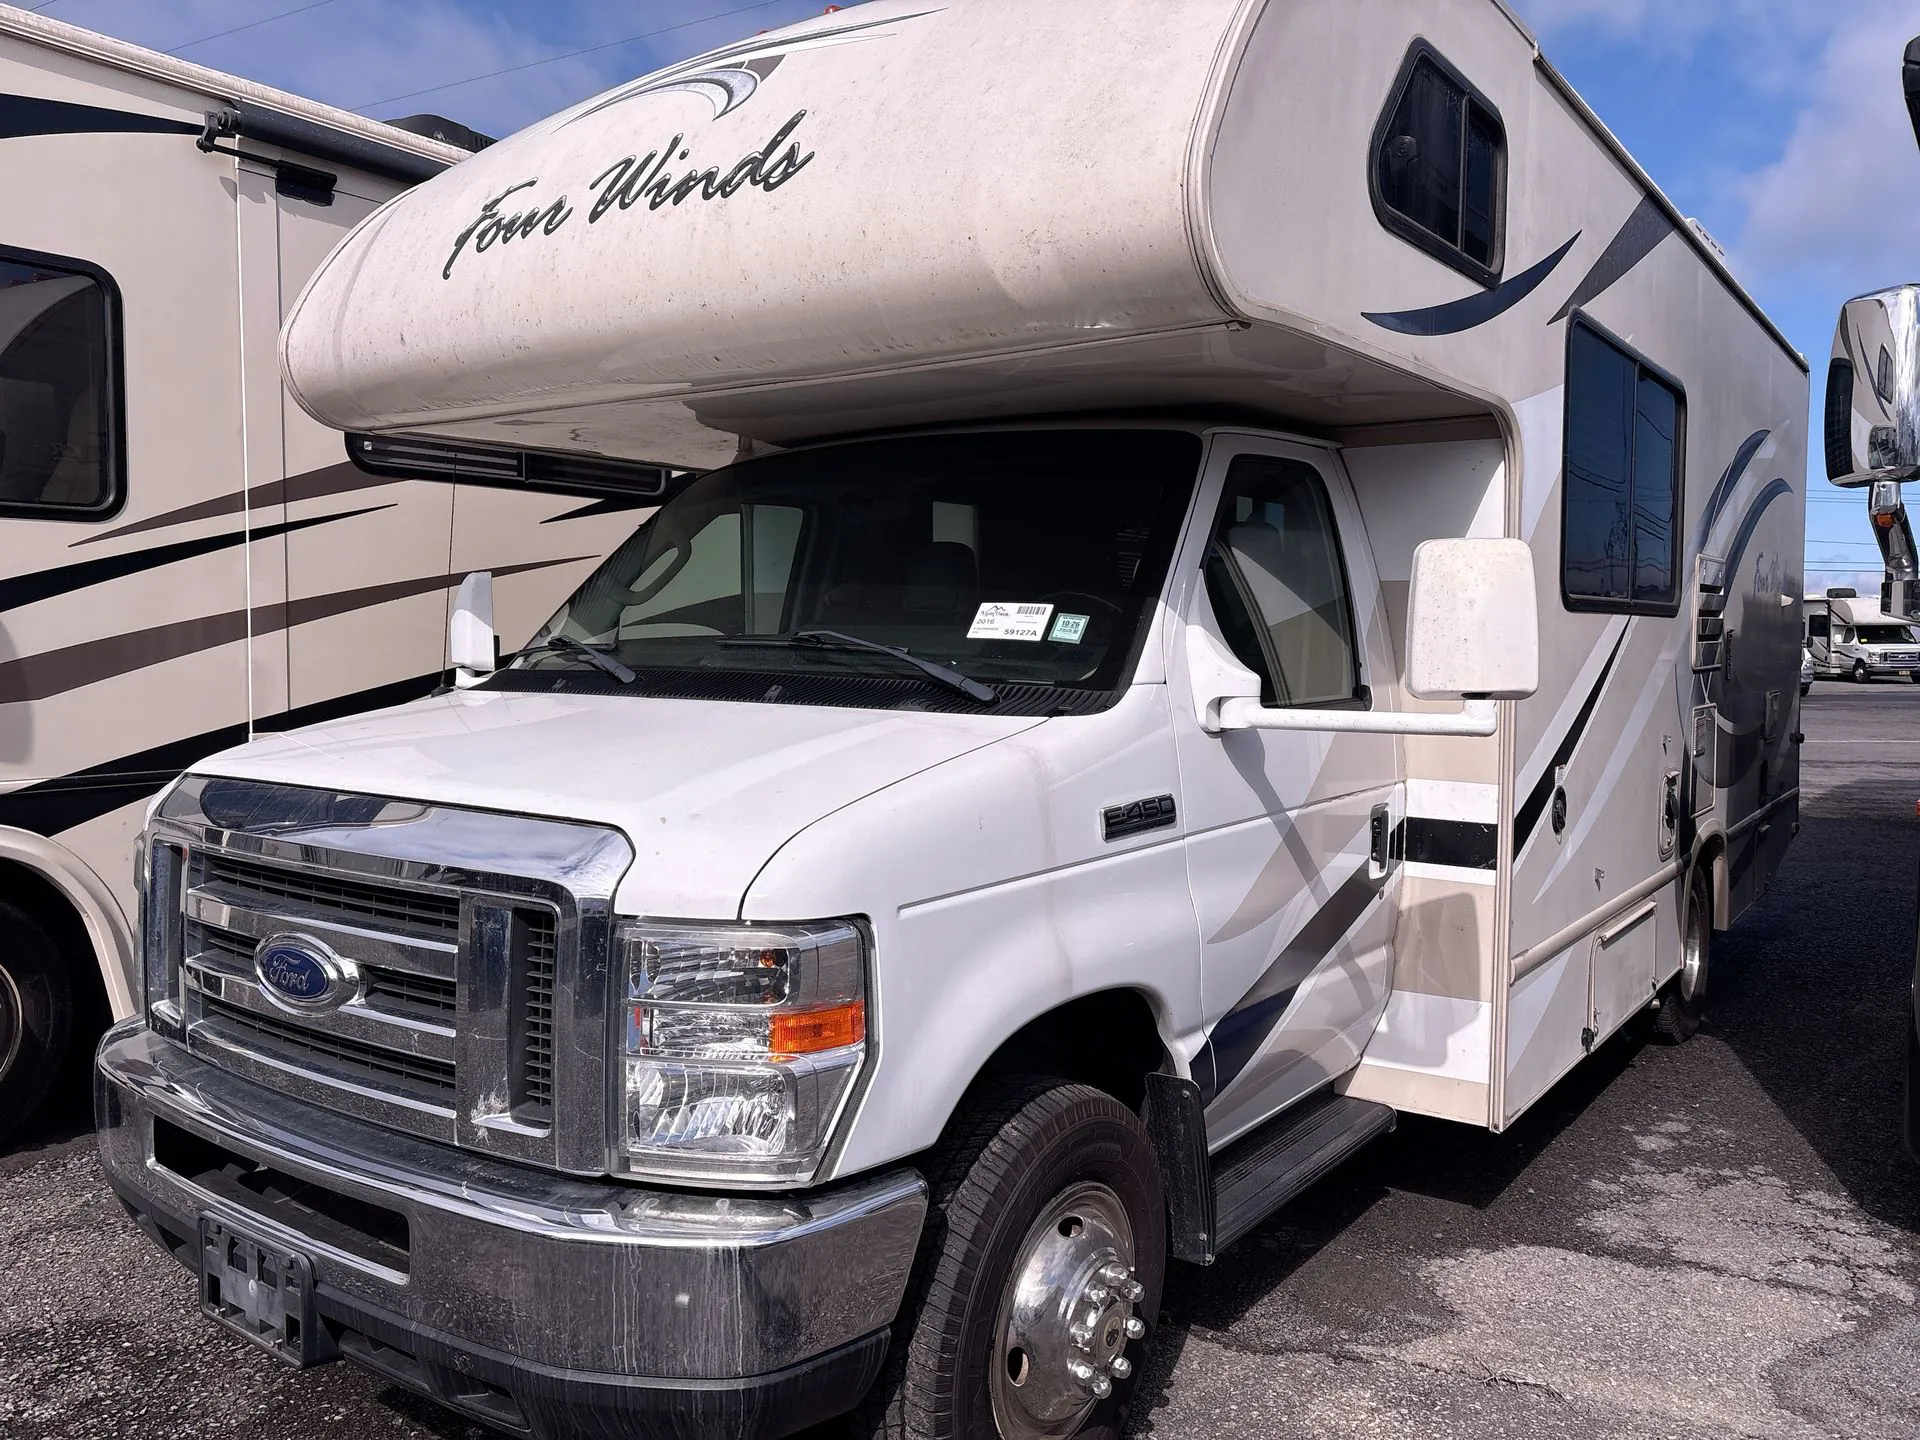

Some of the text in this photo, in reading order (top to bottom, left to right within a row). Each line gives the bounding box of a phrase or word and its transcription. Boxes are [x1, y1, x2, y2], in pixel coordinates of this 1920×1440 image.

[442, 109, 816, 280] Four Winds
[1003, 628, 1038, 637] 59127A
[268, 953, 311, 992] Ford
